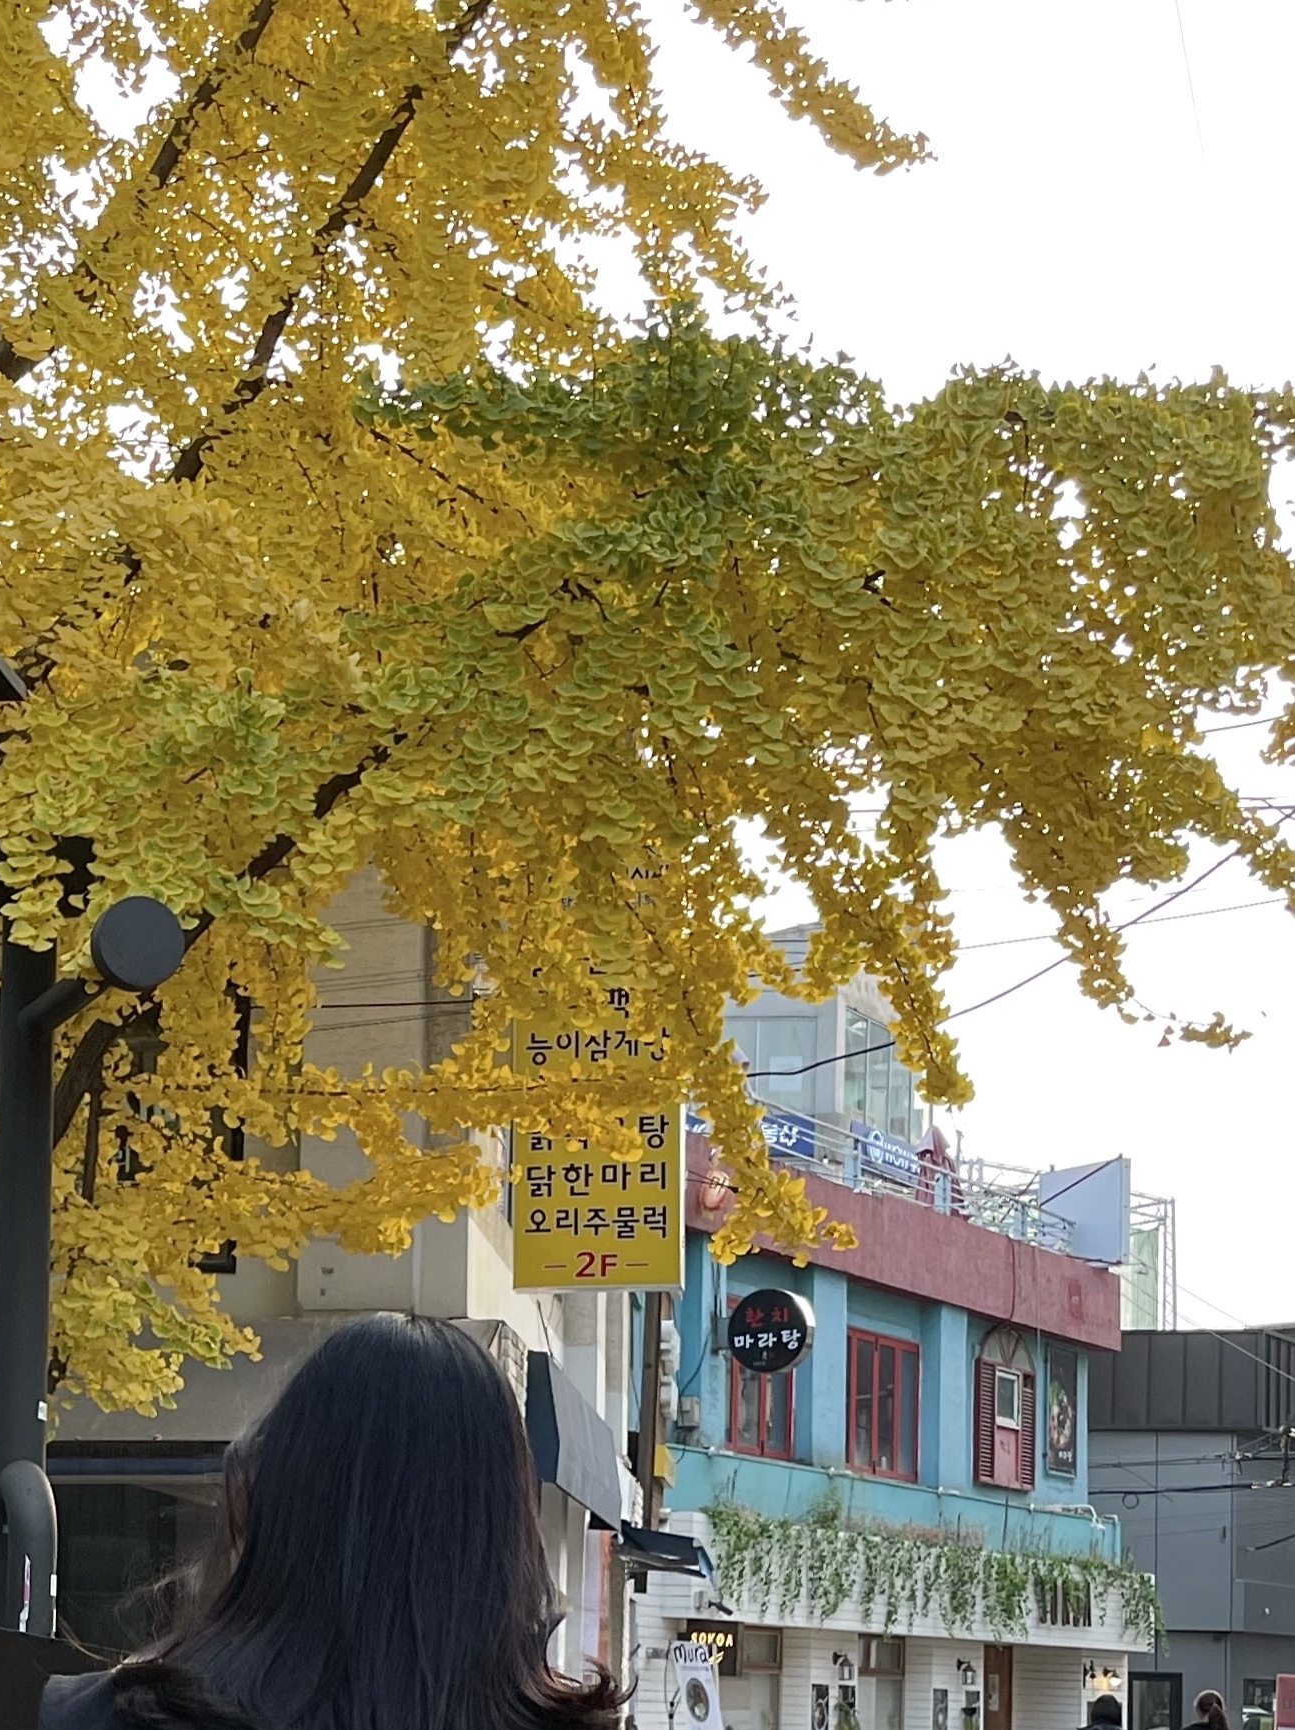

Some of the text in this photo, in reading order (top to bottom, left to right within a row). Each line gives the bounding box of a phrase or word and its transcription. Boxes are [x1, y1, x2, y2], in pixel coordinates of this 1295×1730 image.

[526, 1161, 667, 1198] 닭한마리
[524, 1204, 667, 1239] 오리주물럭
[733, 1328, 802, 1350] 마라탕
